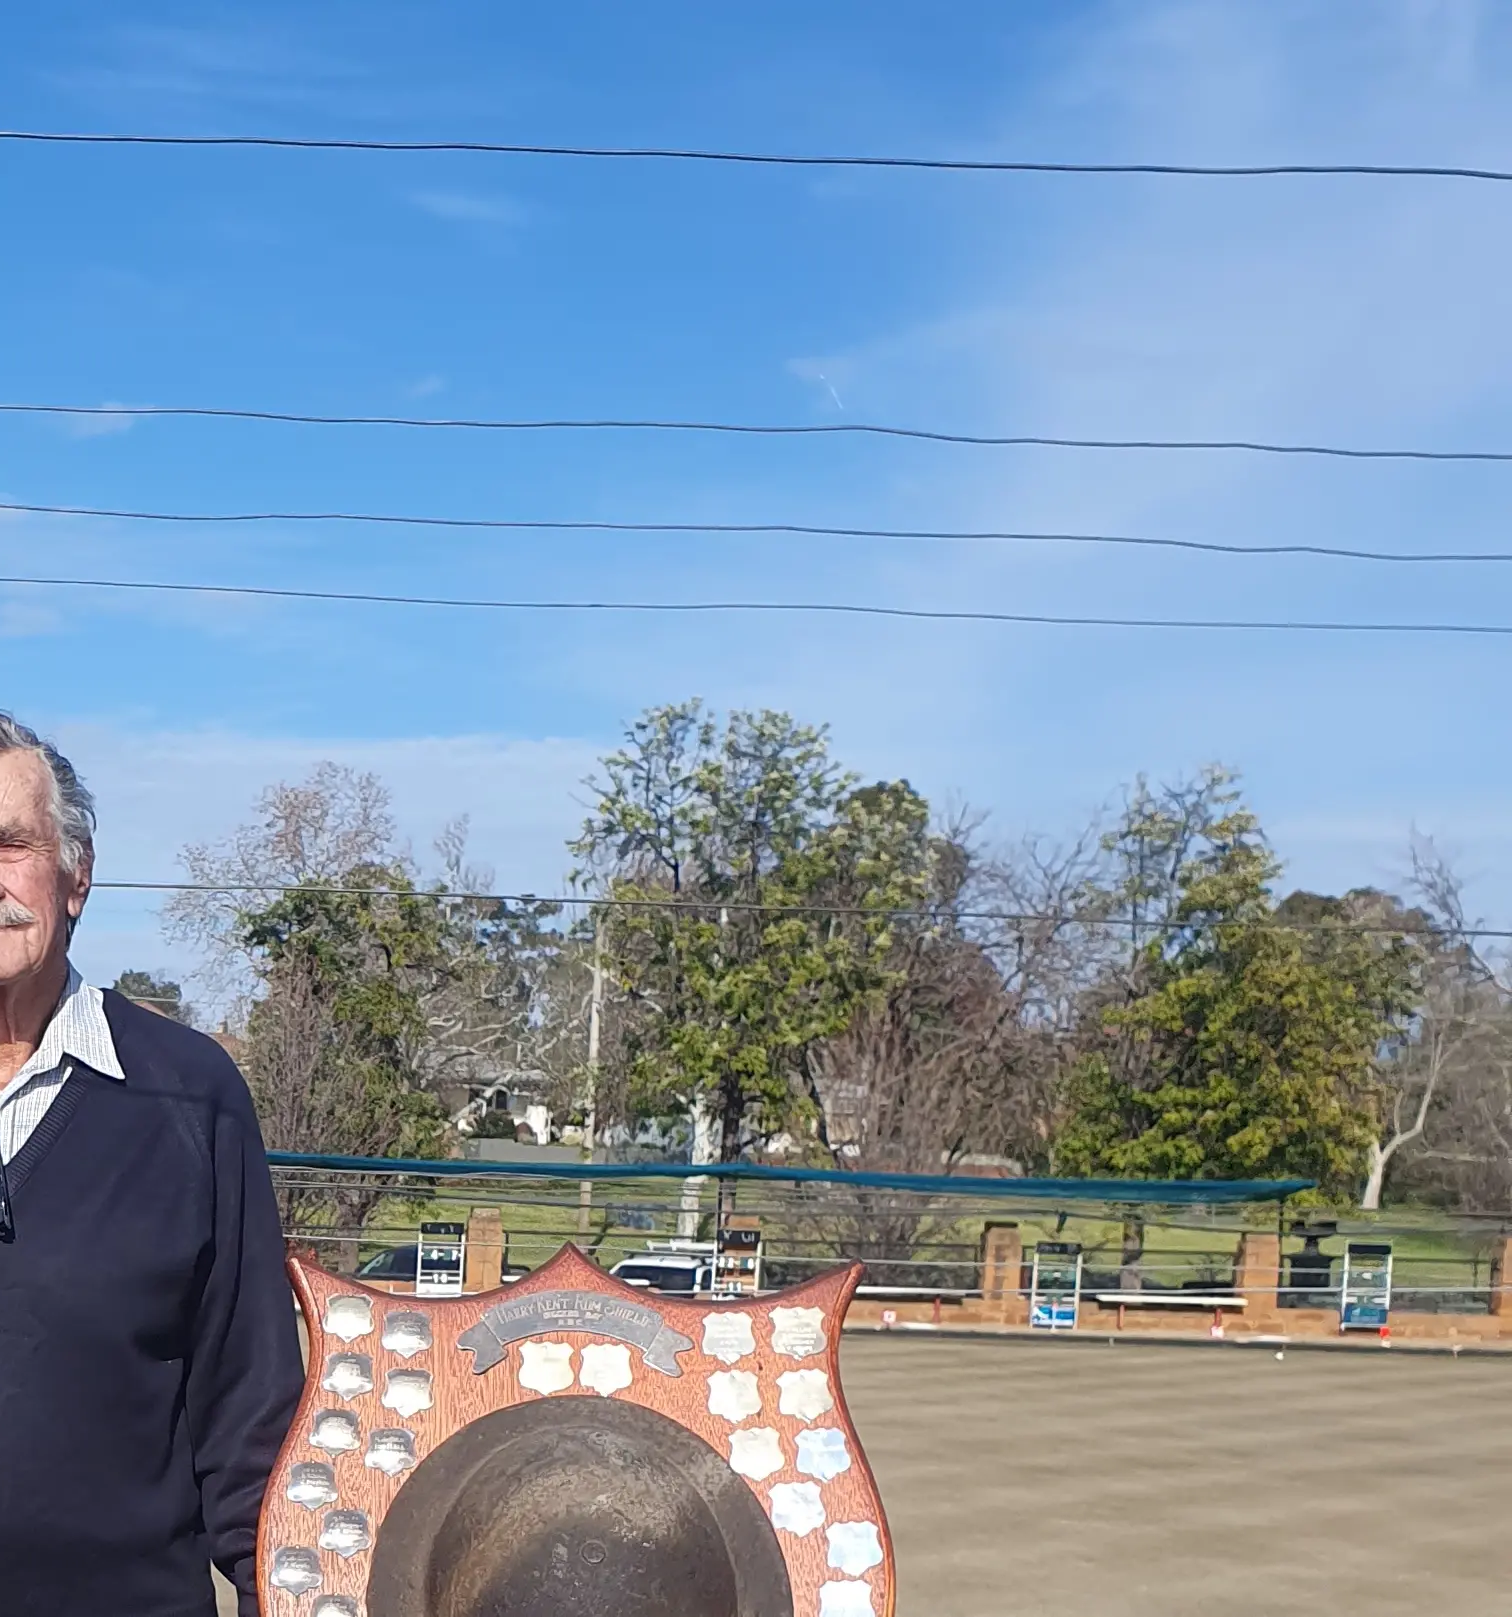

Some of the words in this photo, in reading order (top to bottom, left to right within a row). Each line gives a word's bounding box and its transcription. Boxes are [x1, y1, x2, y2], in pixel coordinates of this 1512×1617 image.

[496, 1302, 534, 1325] HARRY
[535, 1295, 570, 1312] KENT
[574, 1294, 602, 1312] RUM
[604, 1300, 650, 1328] SHIELD
